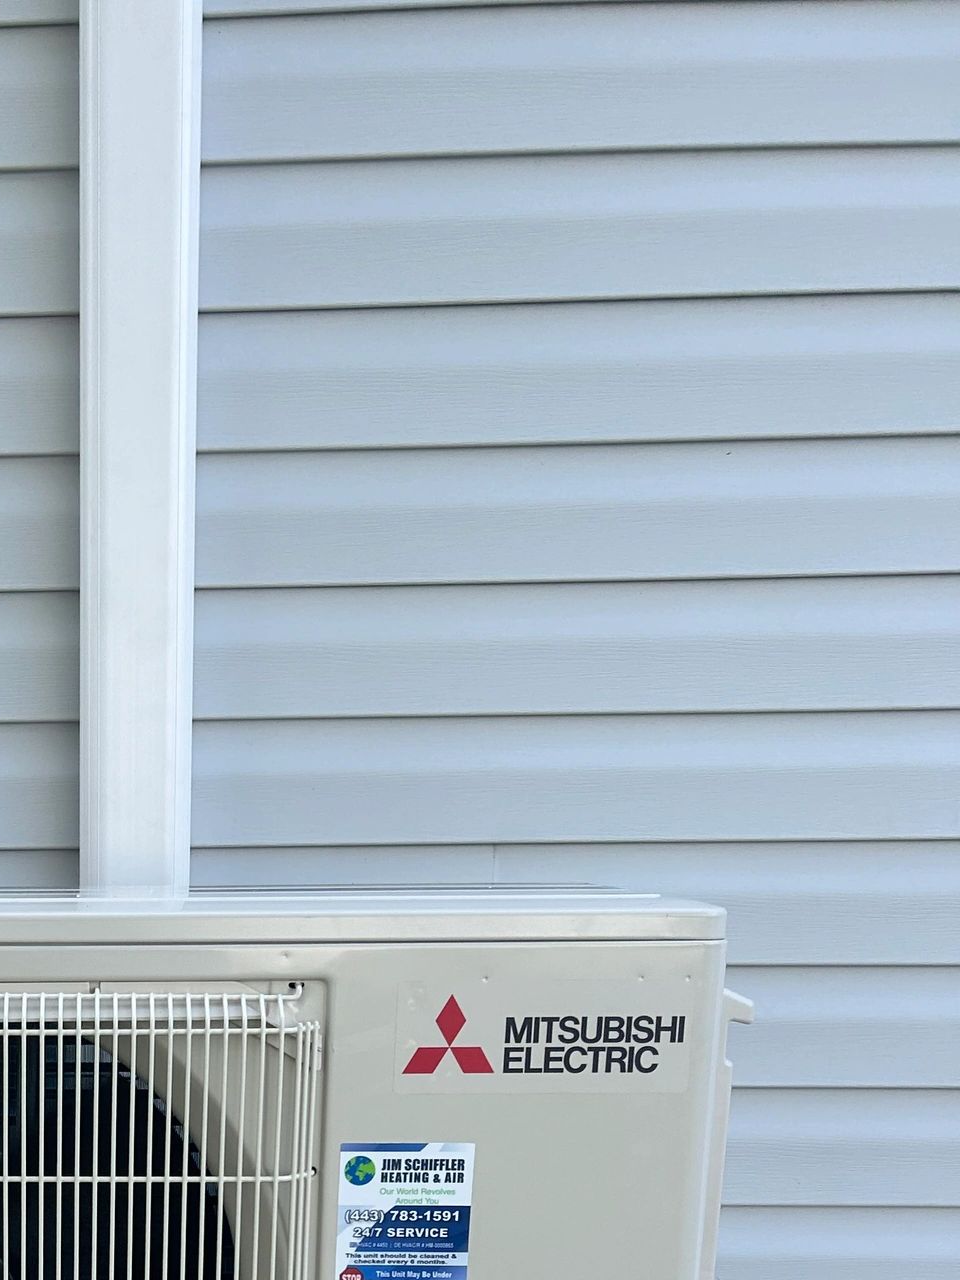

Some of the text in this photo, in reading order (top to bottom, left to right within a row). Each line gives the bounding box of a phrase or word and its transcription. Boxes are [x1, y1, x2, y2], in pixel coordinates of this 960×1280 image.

[504, 1015, 686, 1044] MITSUBISHI
[502, 1046, 660, 1074] ELECTRIC
[381, 1158, 465, 1171] JIM SCHIFFLER
[380, 1172, 465, 1184] HEATING & AIR
[379, 1187, 456, 1196] Our World Revolves
[395, 1197, 440, 1205] Around You
[344, 1209, 460, 1224] (443) 783-1591
[353, 1227, 449, 1238] 24/7 SERVICE
[376, 1270, 452, 1280] This Unit May Be Under
